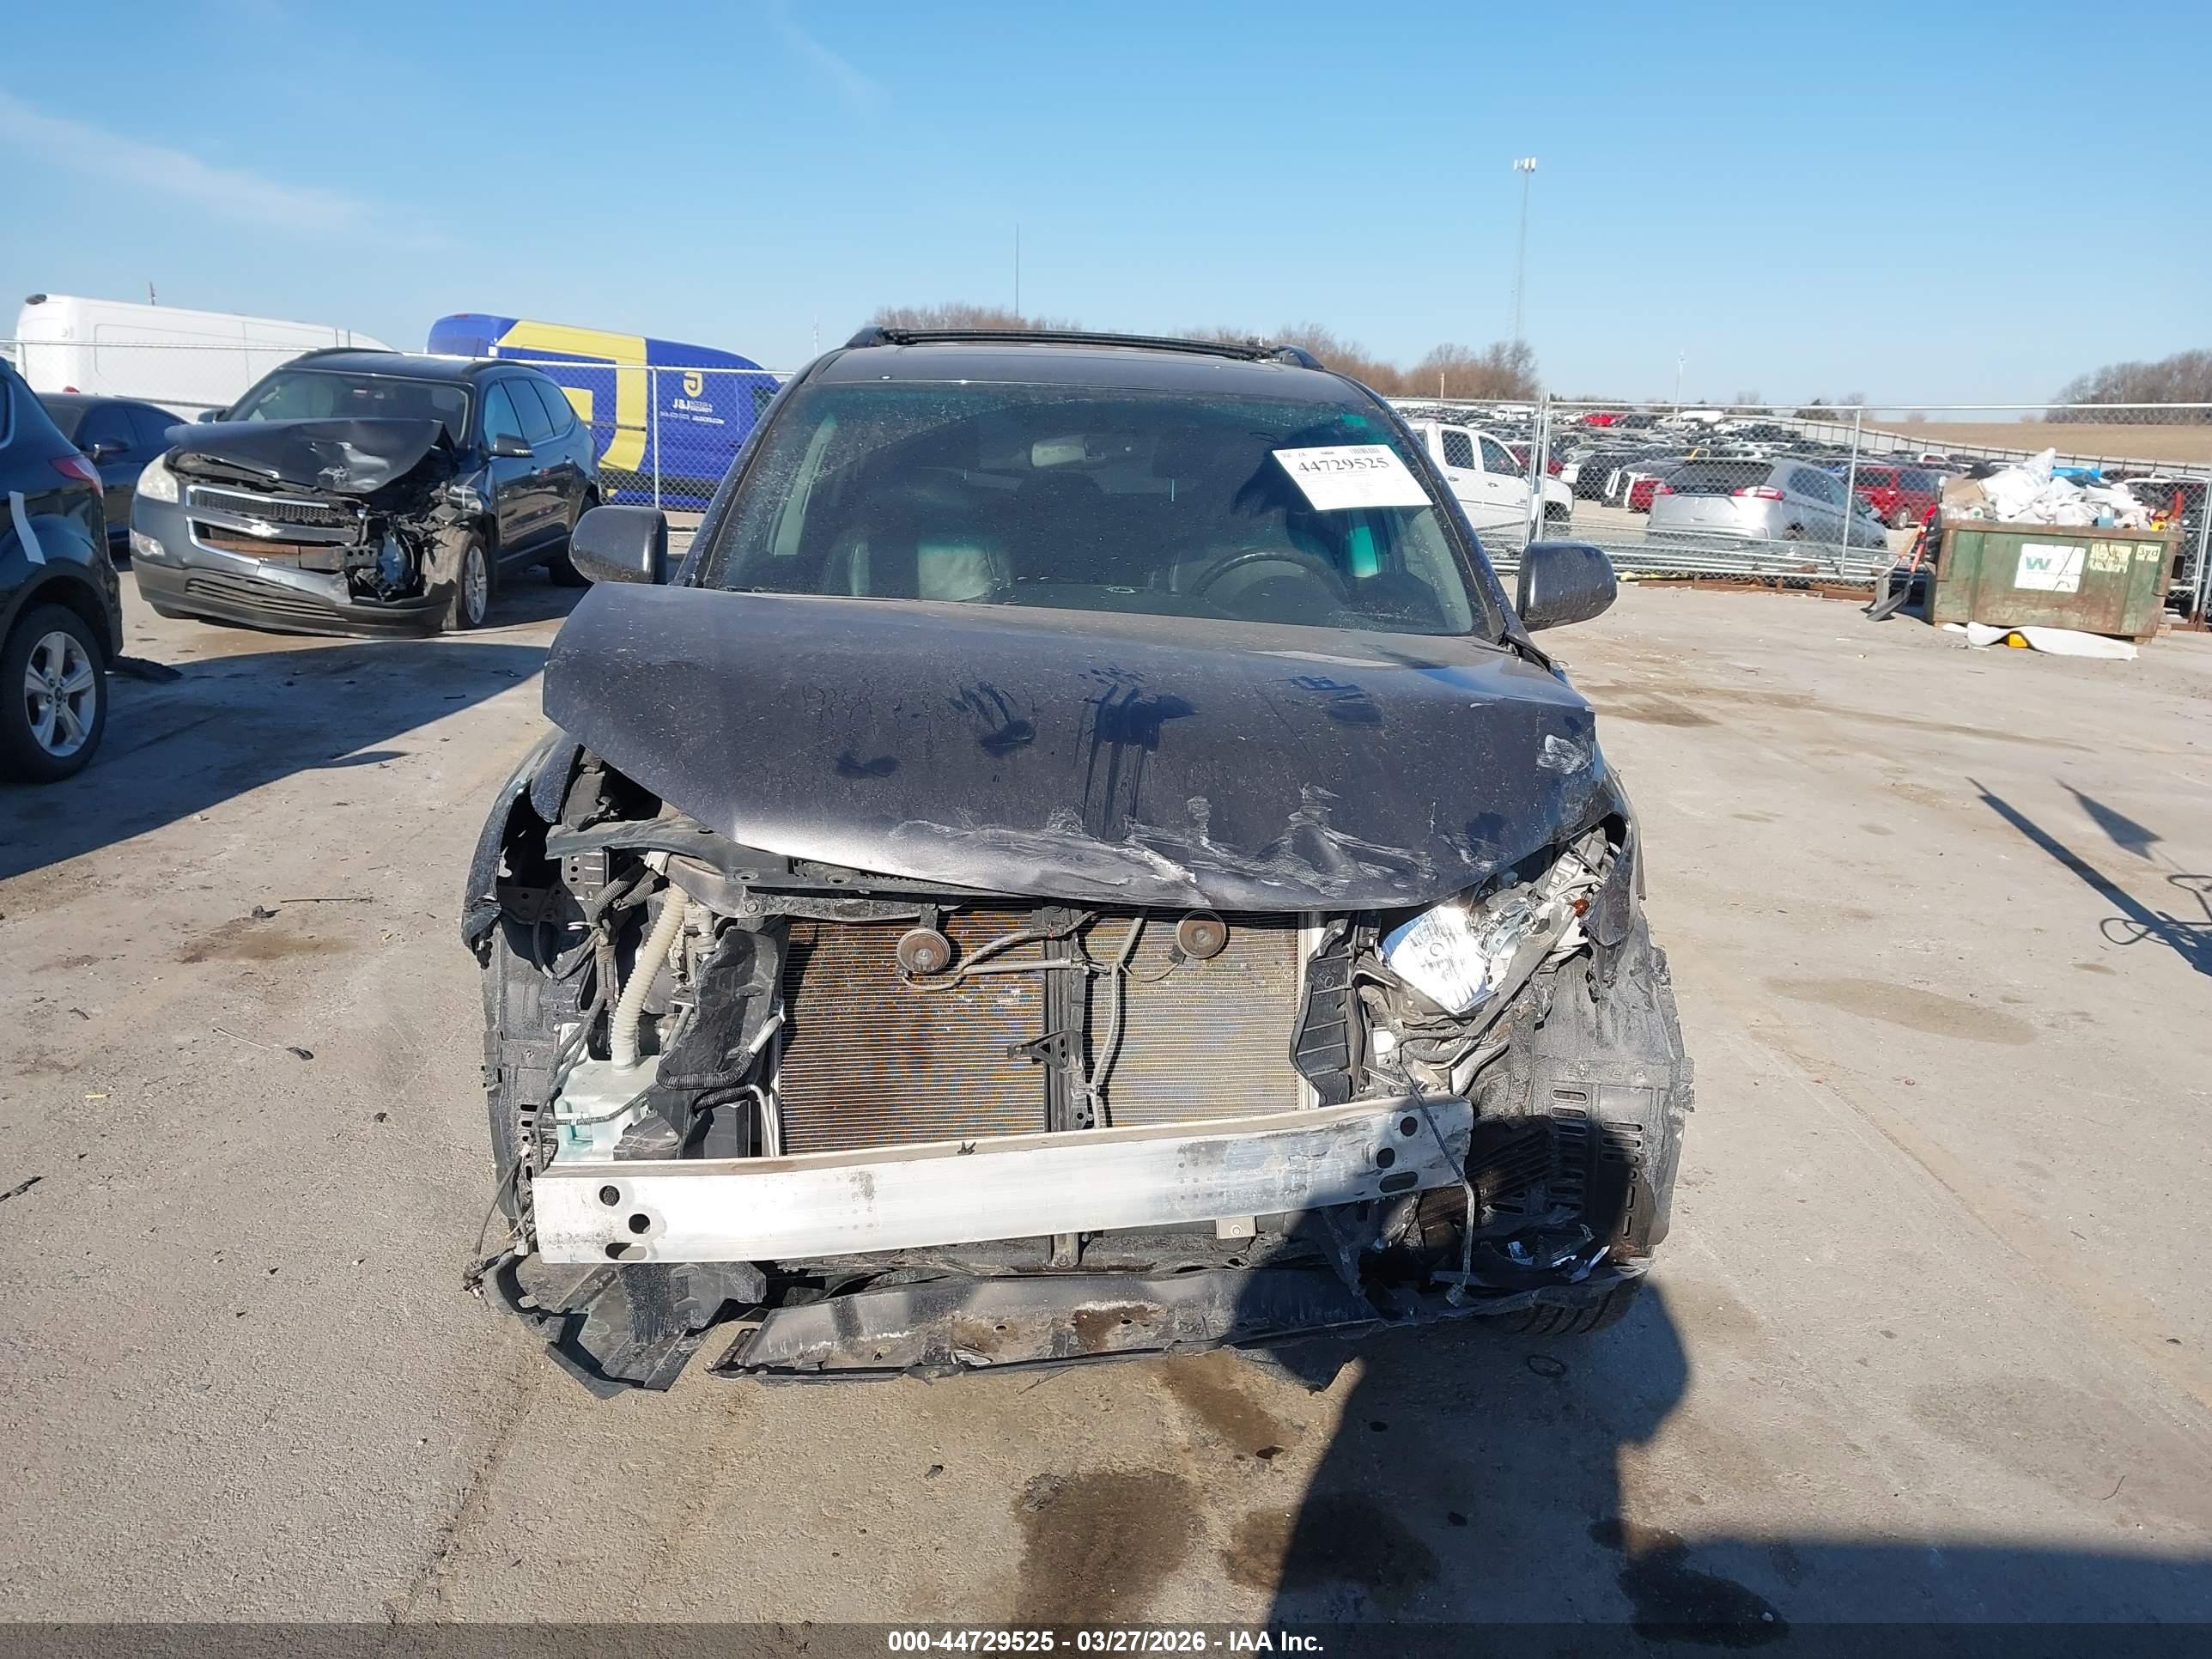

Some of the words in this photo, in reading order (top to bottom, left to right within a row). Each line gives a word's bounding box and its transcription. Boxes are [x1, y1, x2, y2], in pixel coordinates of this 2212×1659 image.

[672, 398, 690, 410] J&J
[1298, 458, 1389, 472] 44729525
[2138, 547, 2159, 560] 3yd
